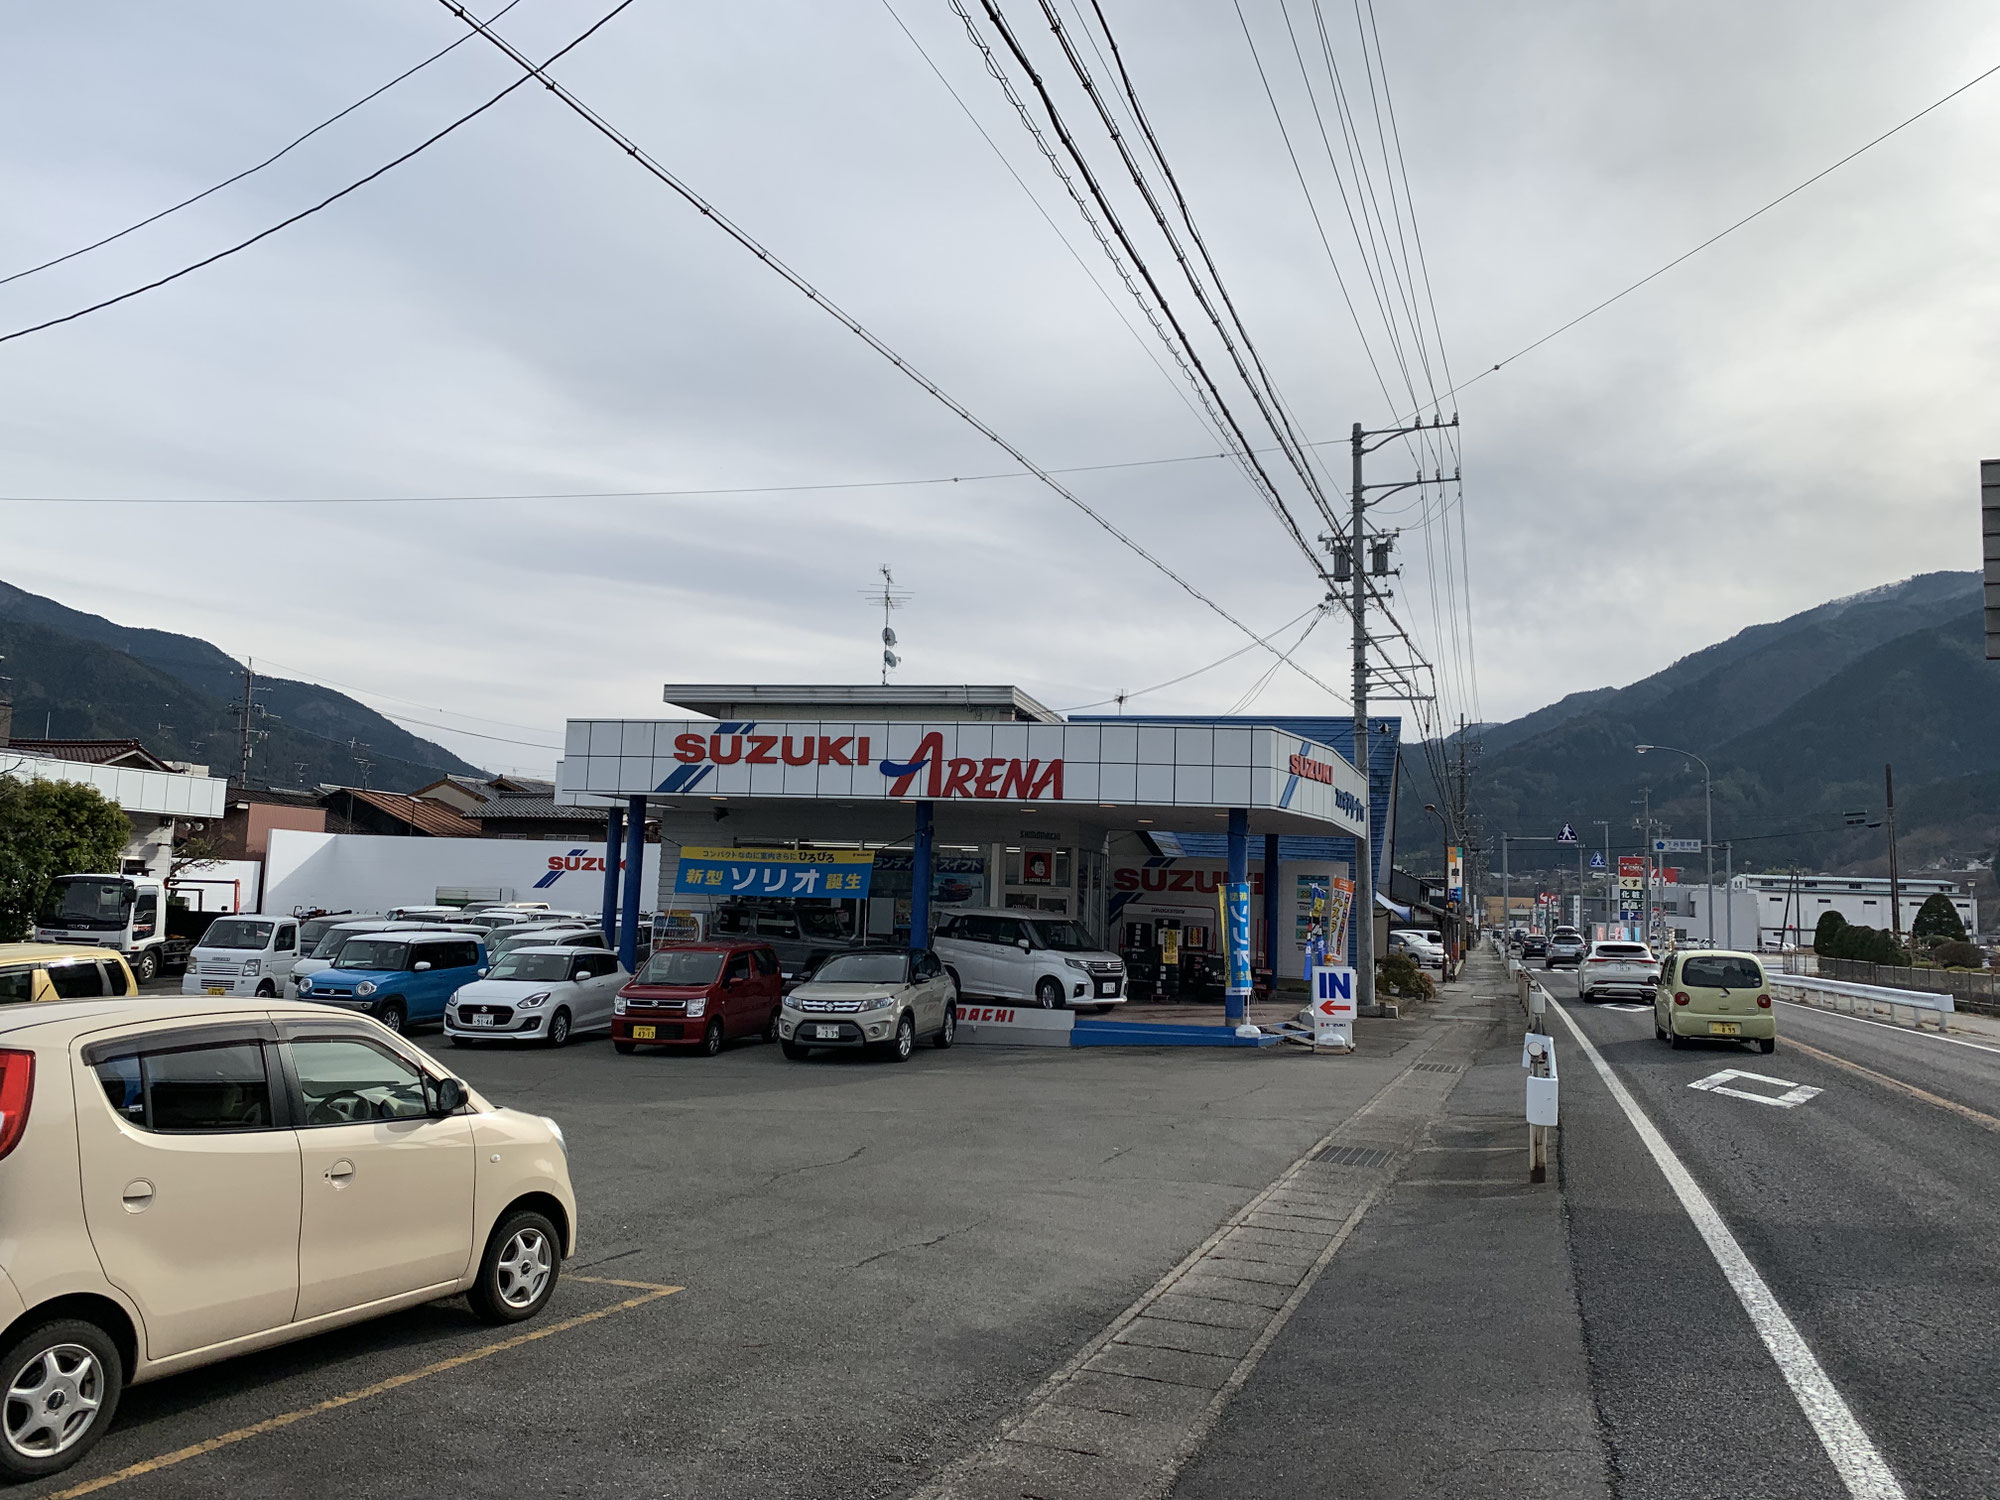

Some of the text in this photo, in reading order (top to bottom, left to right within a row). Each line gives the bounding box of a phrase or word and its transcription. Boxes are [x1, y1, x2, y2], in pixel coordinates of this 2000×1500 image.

[673, 731, 1063, 800] SUZUKI ARENA
[1289, 753, 1334, 785] SUZUKI
[939, 859, 981, 872] スイフト
[685, 867, 863, 894] 新型 ソリオ 誕生
[1113, 867, 1265, 895] SUZUI
[1319, 972, 1351, 999] IN
